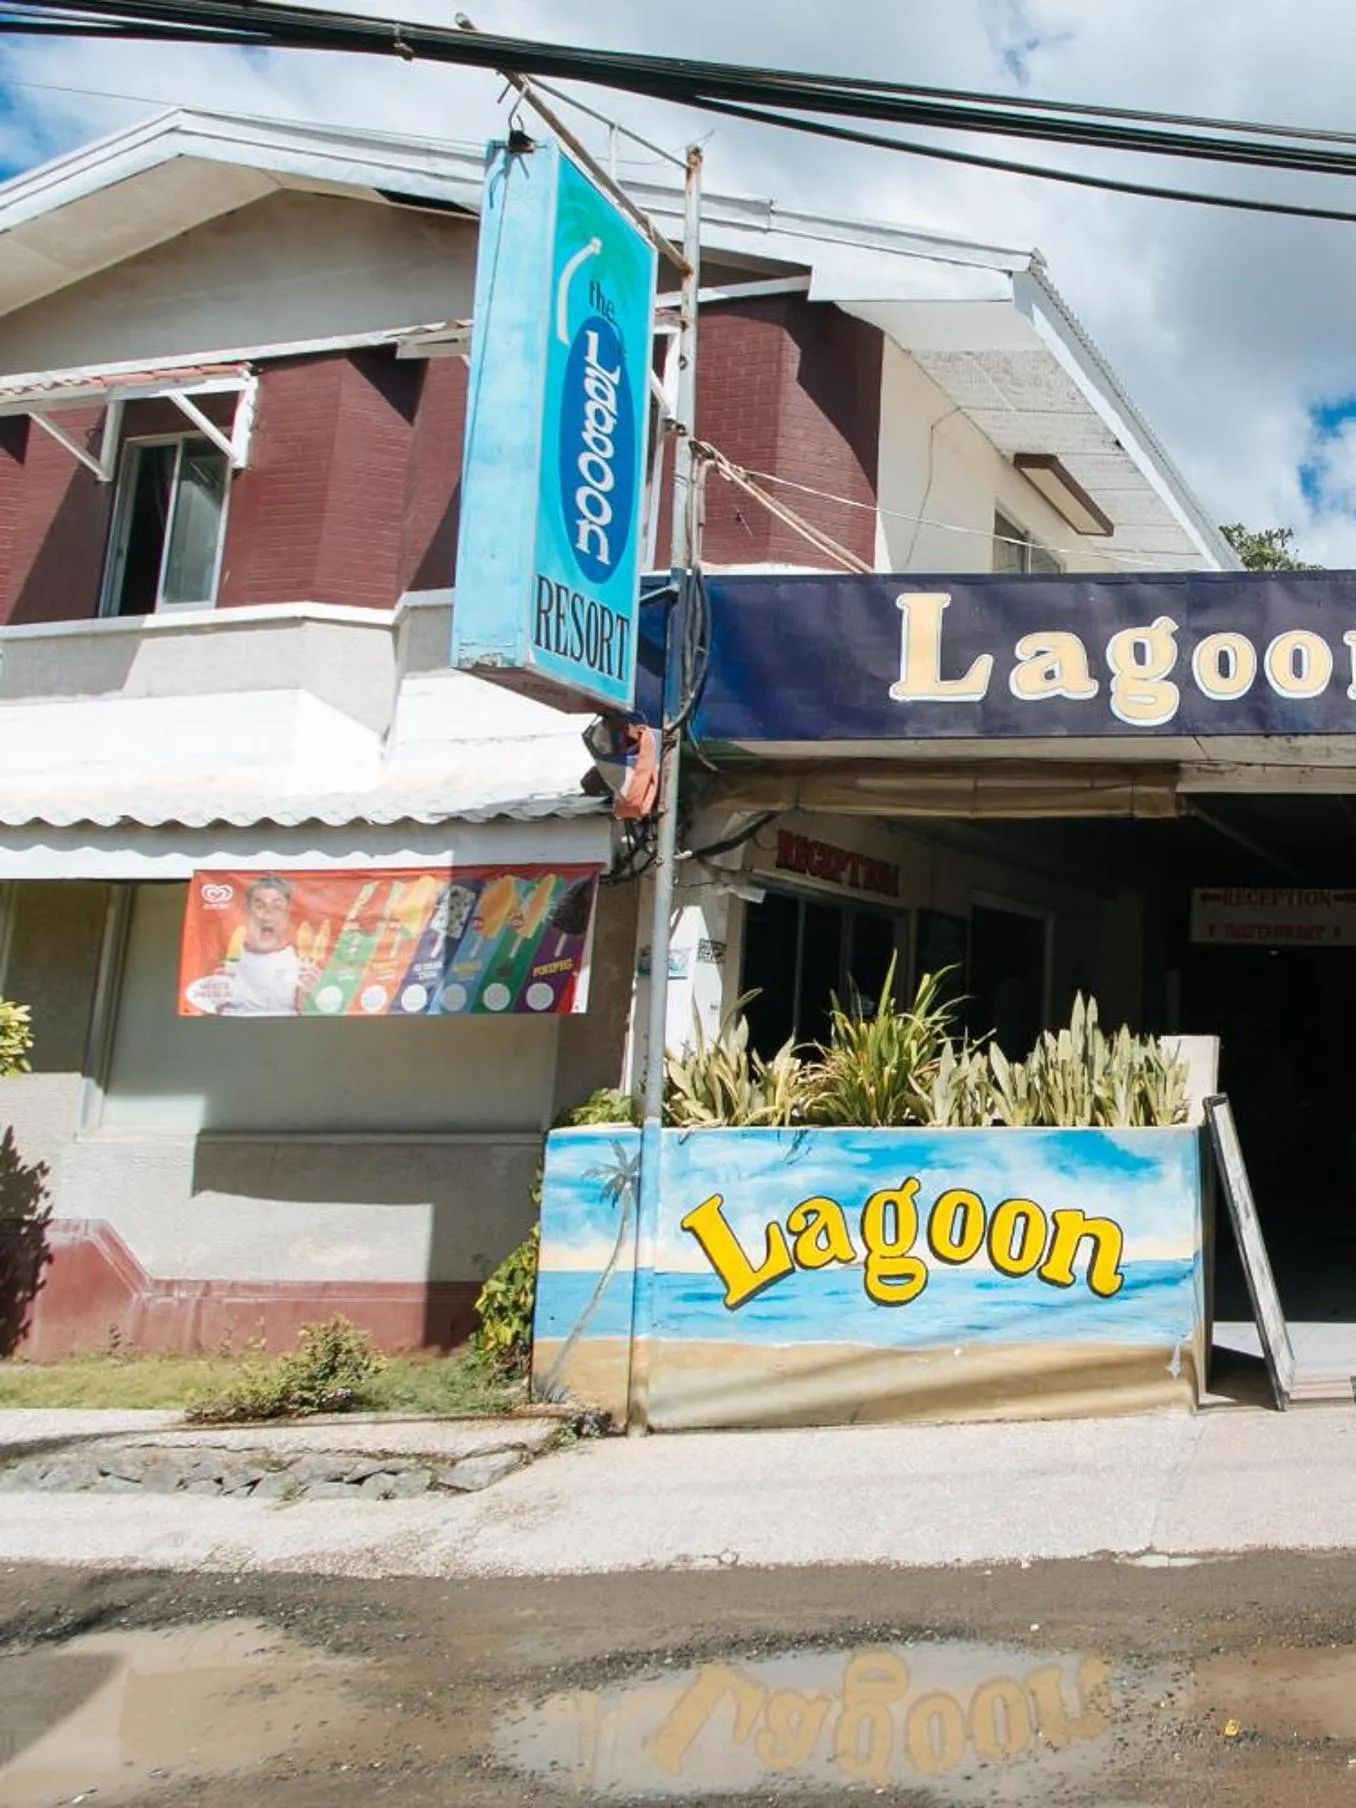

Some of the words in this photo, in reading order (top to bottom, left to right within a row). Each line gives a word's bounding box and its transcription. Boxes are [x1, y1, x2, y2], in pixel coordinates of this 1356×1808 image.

[589, 279, 617, 325] the
[576, 329, 621, 567] Lagoon
[534, 574, 631, 681] RESORT
[776, 830, 900, 897] RECEPTION
[1223, 890, 1331, 909] RECEPTION
[679, 1176, 1125, 1306] Lagoon
